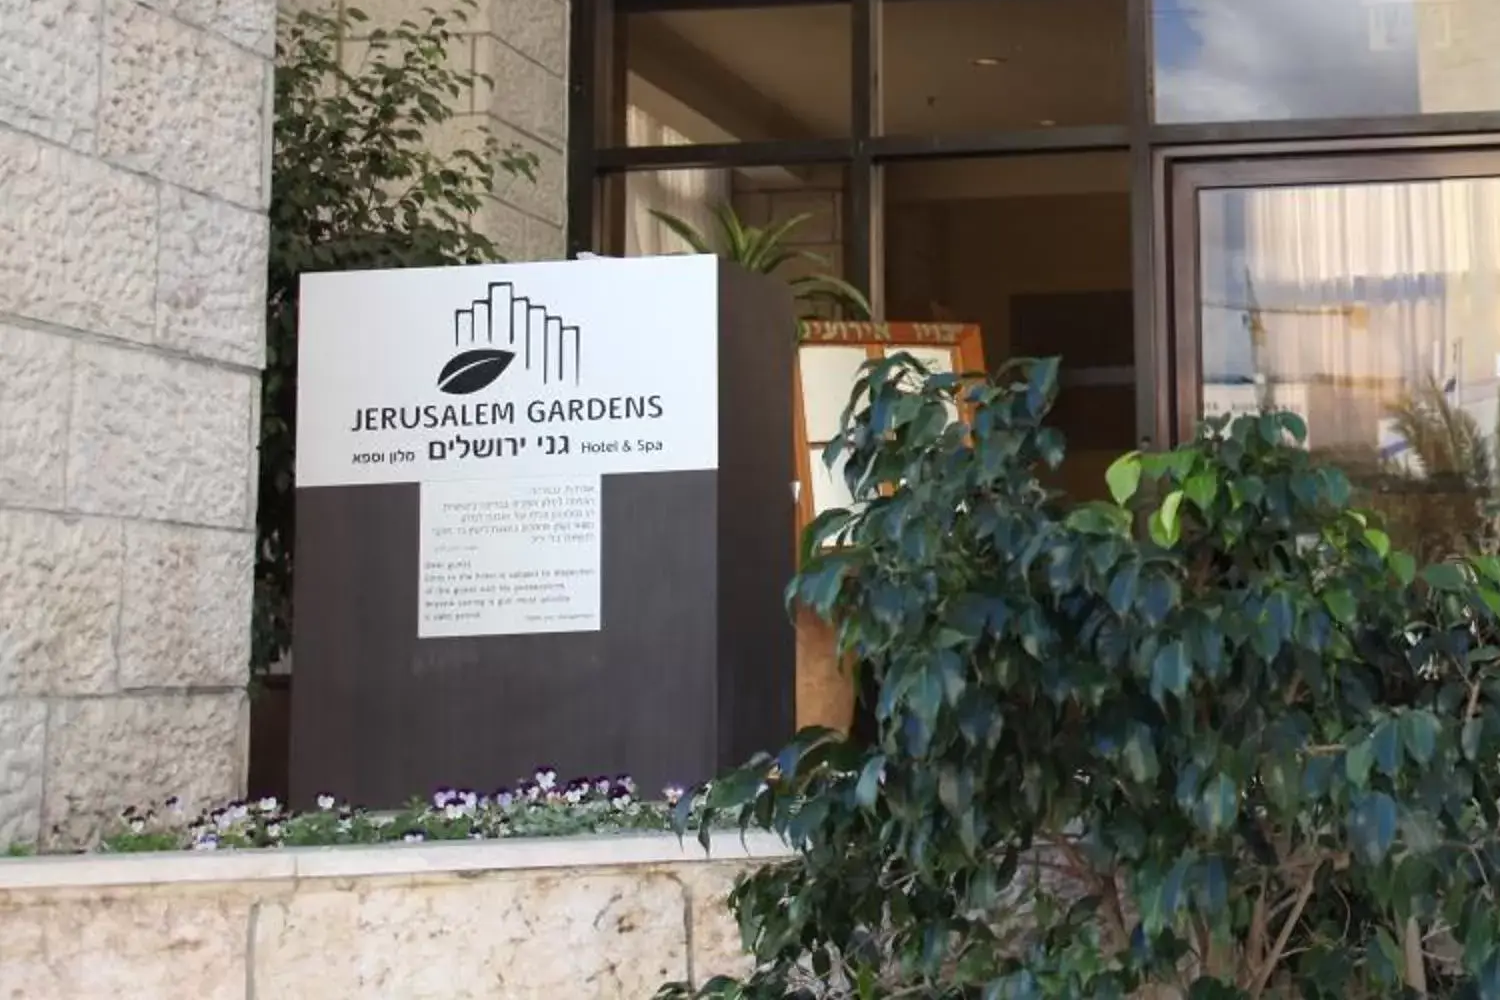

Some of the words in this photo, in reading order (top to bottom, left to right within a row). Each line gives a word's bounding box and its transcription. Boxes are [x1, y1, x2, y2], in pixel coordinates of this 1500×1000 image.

[351, 402, 515, 433] JERUSALEM
[527, 395, 663, 423] GARDENS
[428, 434, 527, 461] ירושלים
[537, 435, 569, 455] גני
[581, 440, 619, 454] Hotel
[622, 440, 632, 453] &
[637, 439, 663, 454] Spa
[351, 452, 385, 464] וספא
[389, 449, 416, 465] מלון
